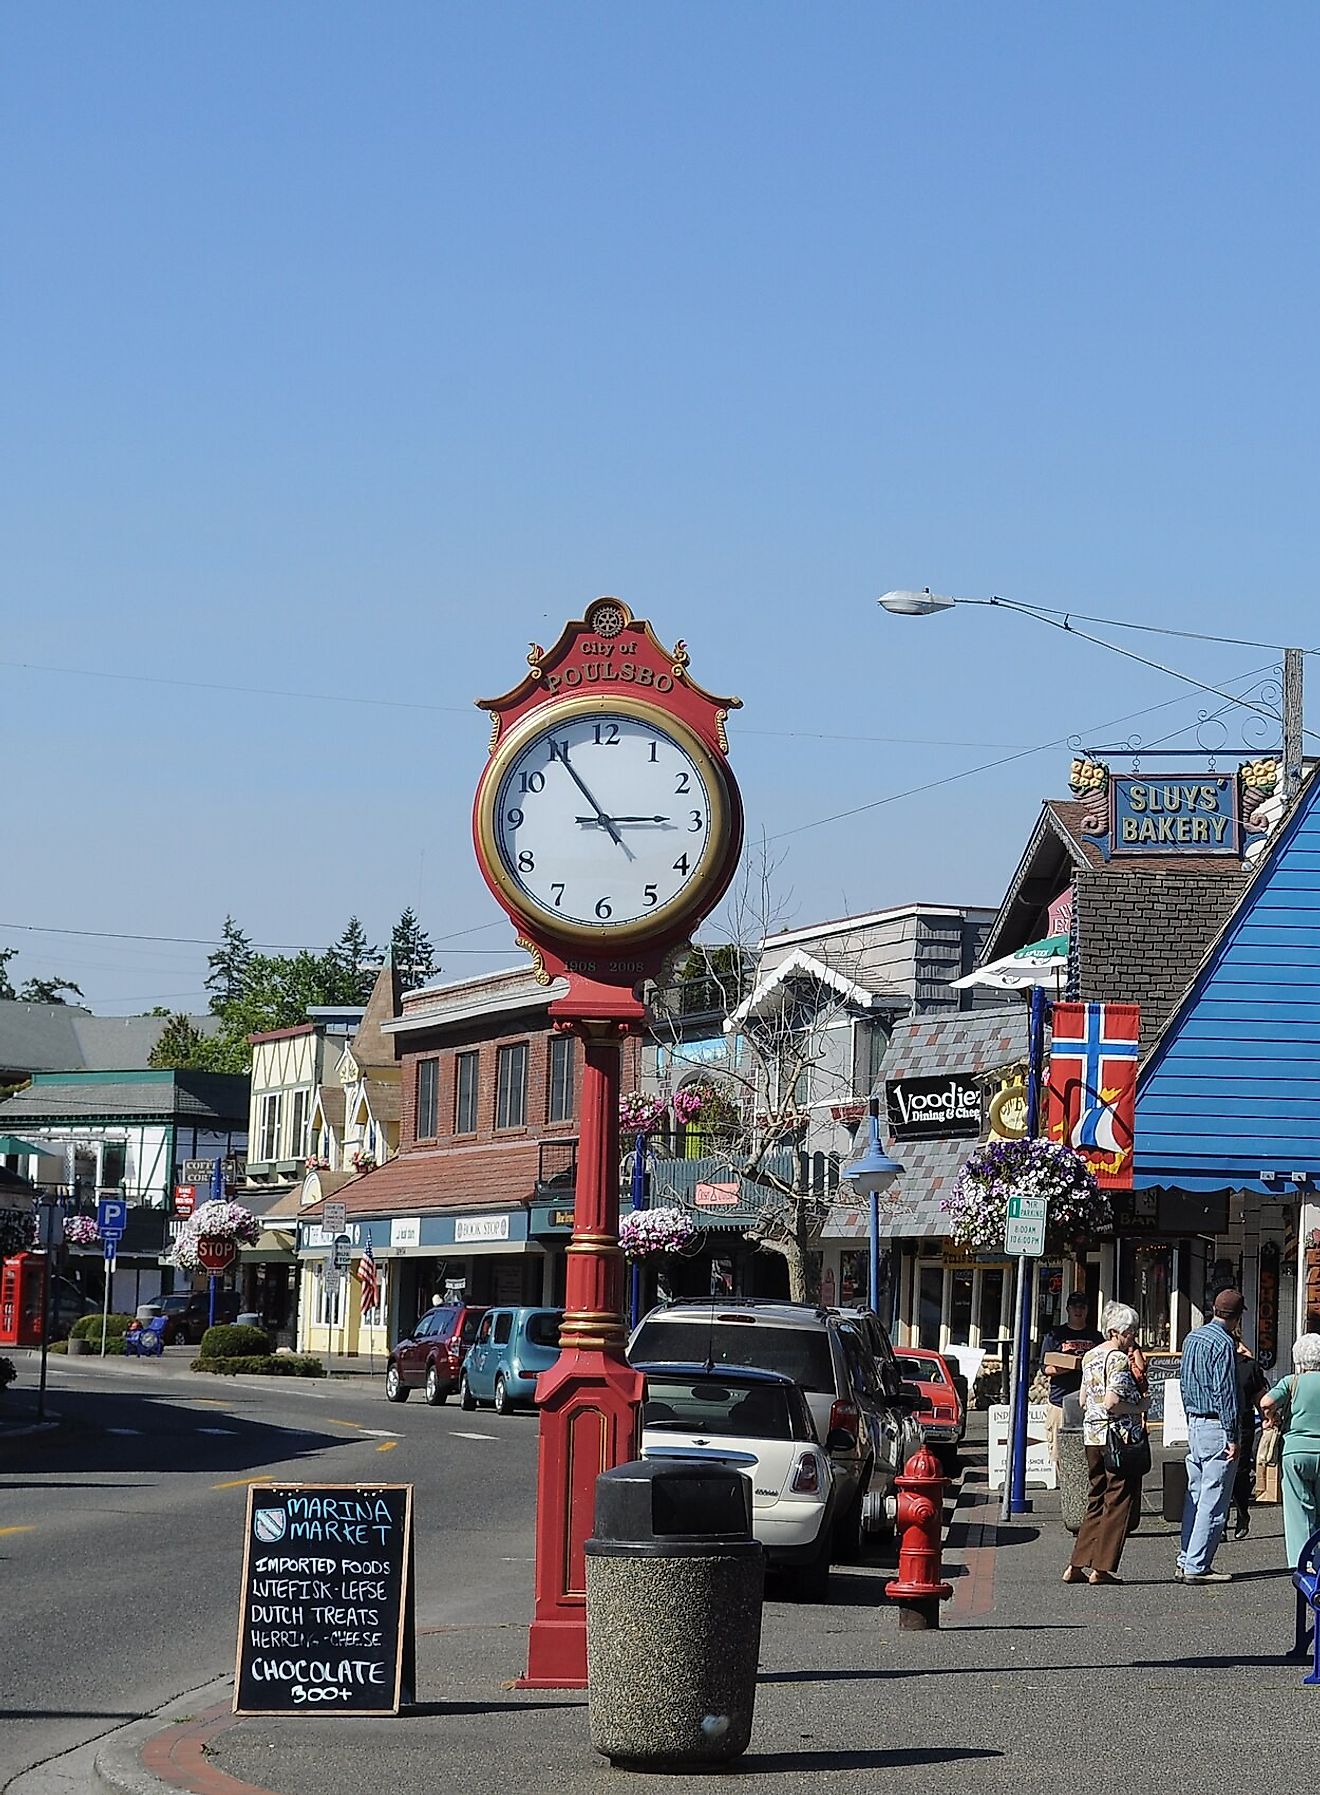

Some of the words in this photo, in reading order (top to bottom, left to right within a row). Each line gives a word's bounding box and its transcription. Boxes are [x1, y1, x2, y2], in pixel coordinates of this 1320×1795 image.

[580, 641, 615, 660] City
[619, 640, 637, 655] of
[545, 661, 673, 697] POULSBO
[592, 723, 620, 745] 12
[647, 741, 660, 763] 1
[518, 770, 546, 794] 10
[674, 772, 692, 795] 2
[507, 807, 525, 832] 9
[687, 810, 704, 833] 3
[1121, 816, 1228, 843] BAKERY
[517, 849, 536, 873] 8
[672, 852, 691, 876] 4
[550, 882, 566, 907] 7
[643, 882, 660, 907] 5
[595, 896, 612, 919] 6
[563, 960, 598, 973] 1908
[608, 960, 646, 973] 2008
[911, 1110, 944, 1122] Dining
[946, 1109, 954, 1121] &
[105, 1204, 120, 1225] P
[199, 1241, 233, 1257] STOP
[287, 1498, 393, 1523] MARINA
[290, 1520, 393, 1546] MARKET
[255, 1557, 337, 1576] IMPORTED
[341, 1560, 391, 1575] FOODS
[251, 1605, 303, 1626] DUTCH
[310, 1606, 379, 1627] TREATS
[251, 1656, 386, 1684] CHOCOLATE
[290, 1684, 353, 1704] 300+
